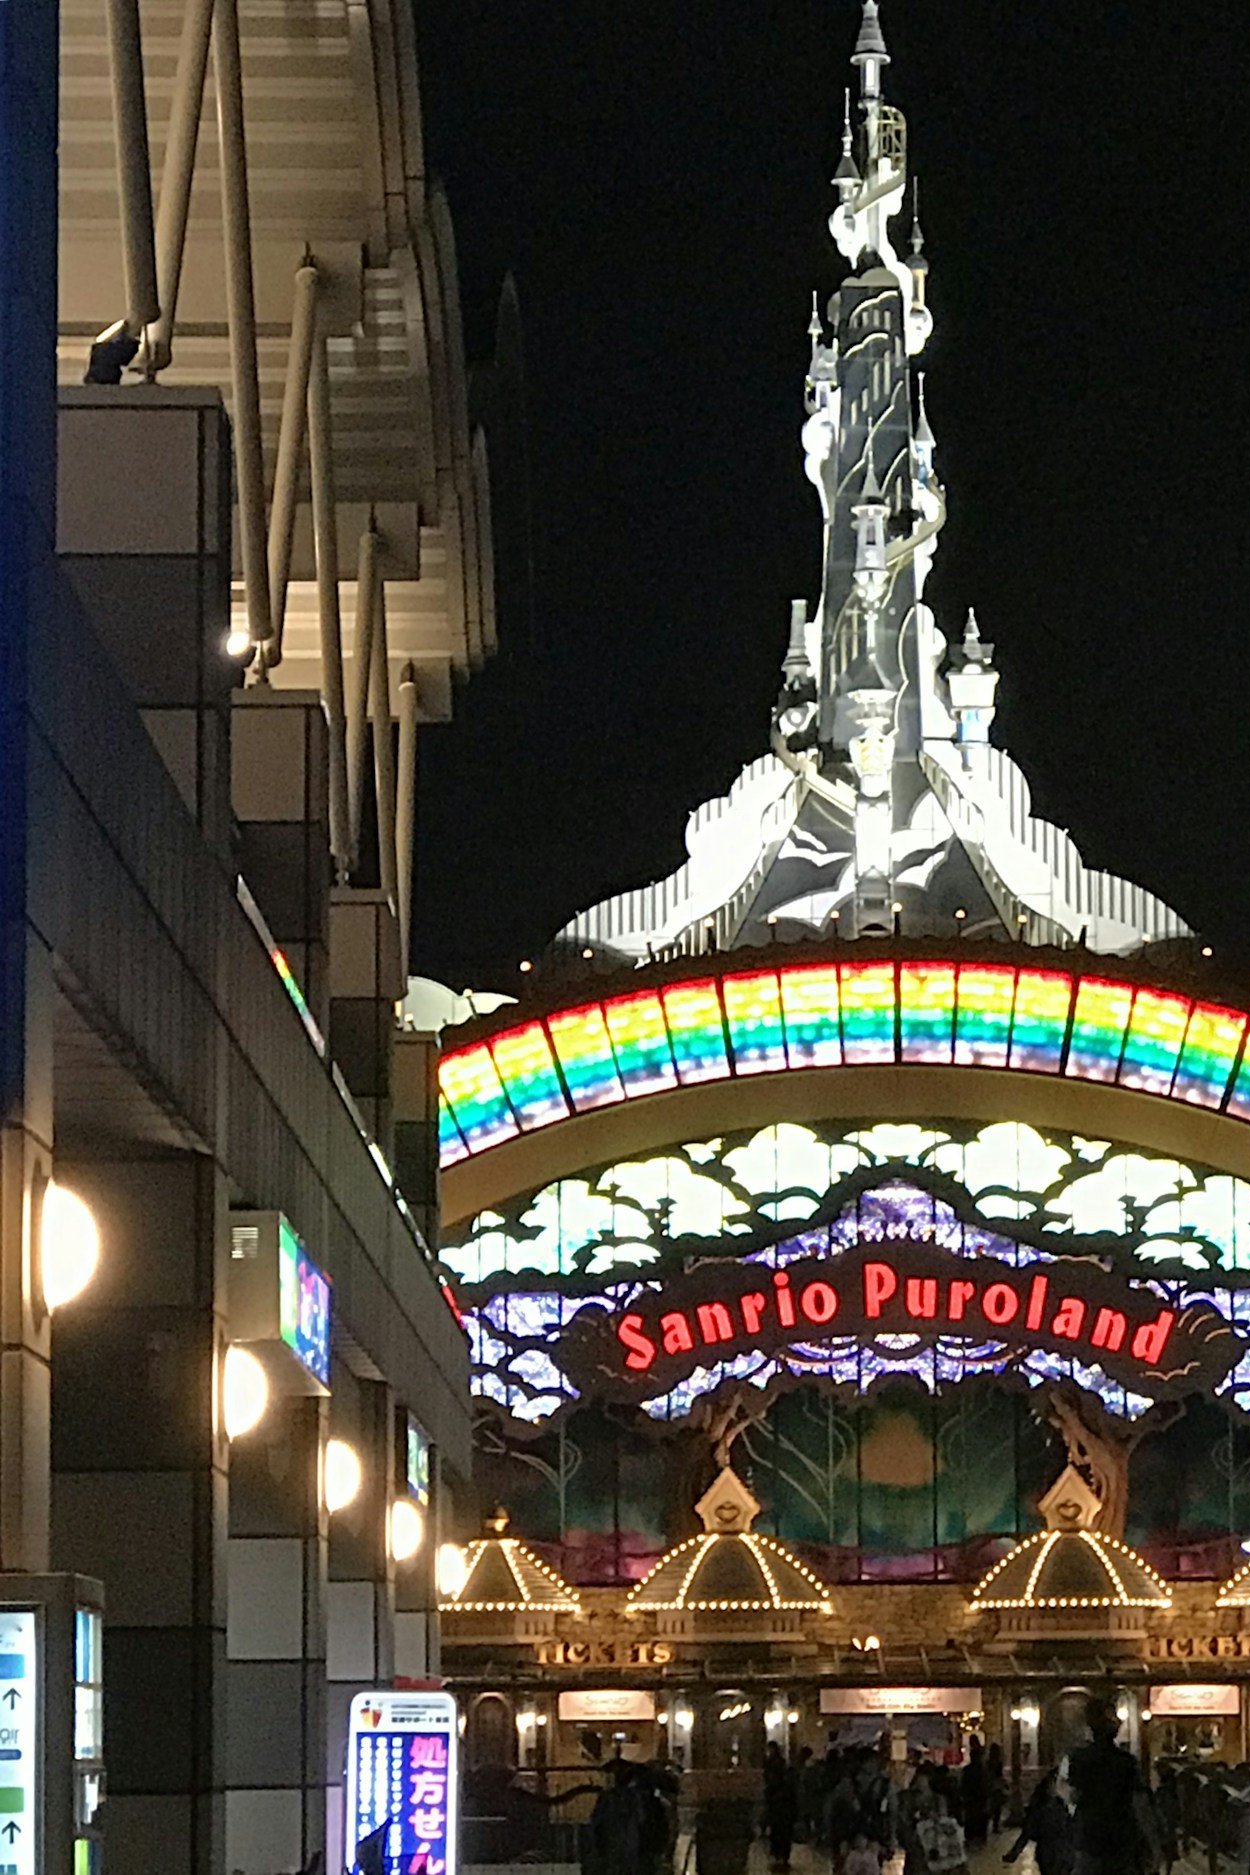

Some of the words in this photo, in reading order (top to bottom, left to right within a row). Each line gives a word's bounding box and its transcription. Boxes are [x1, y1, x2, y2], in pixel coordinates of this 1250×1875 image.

[616, 1271, 838, 1371] Sanrio
[863, 1262, 1176, 1364] Puroland
[537, 1641, 672, 1664] TICKETS
